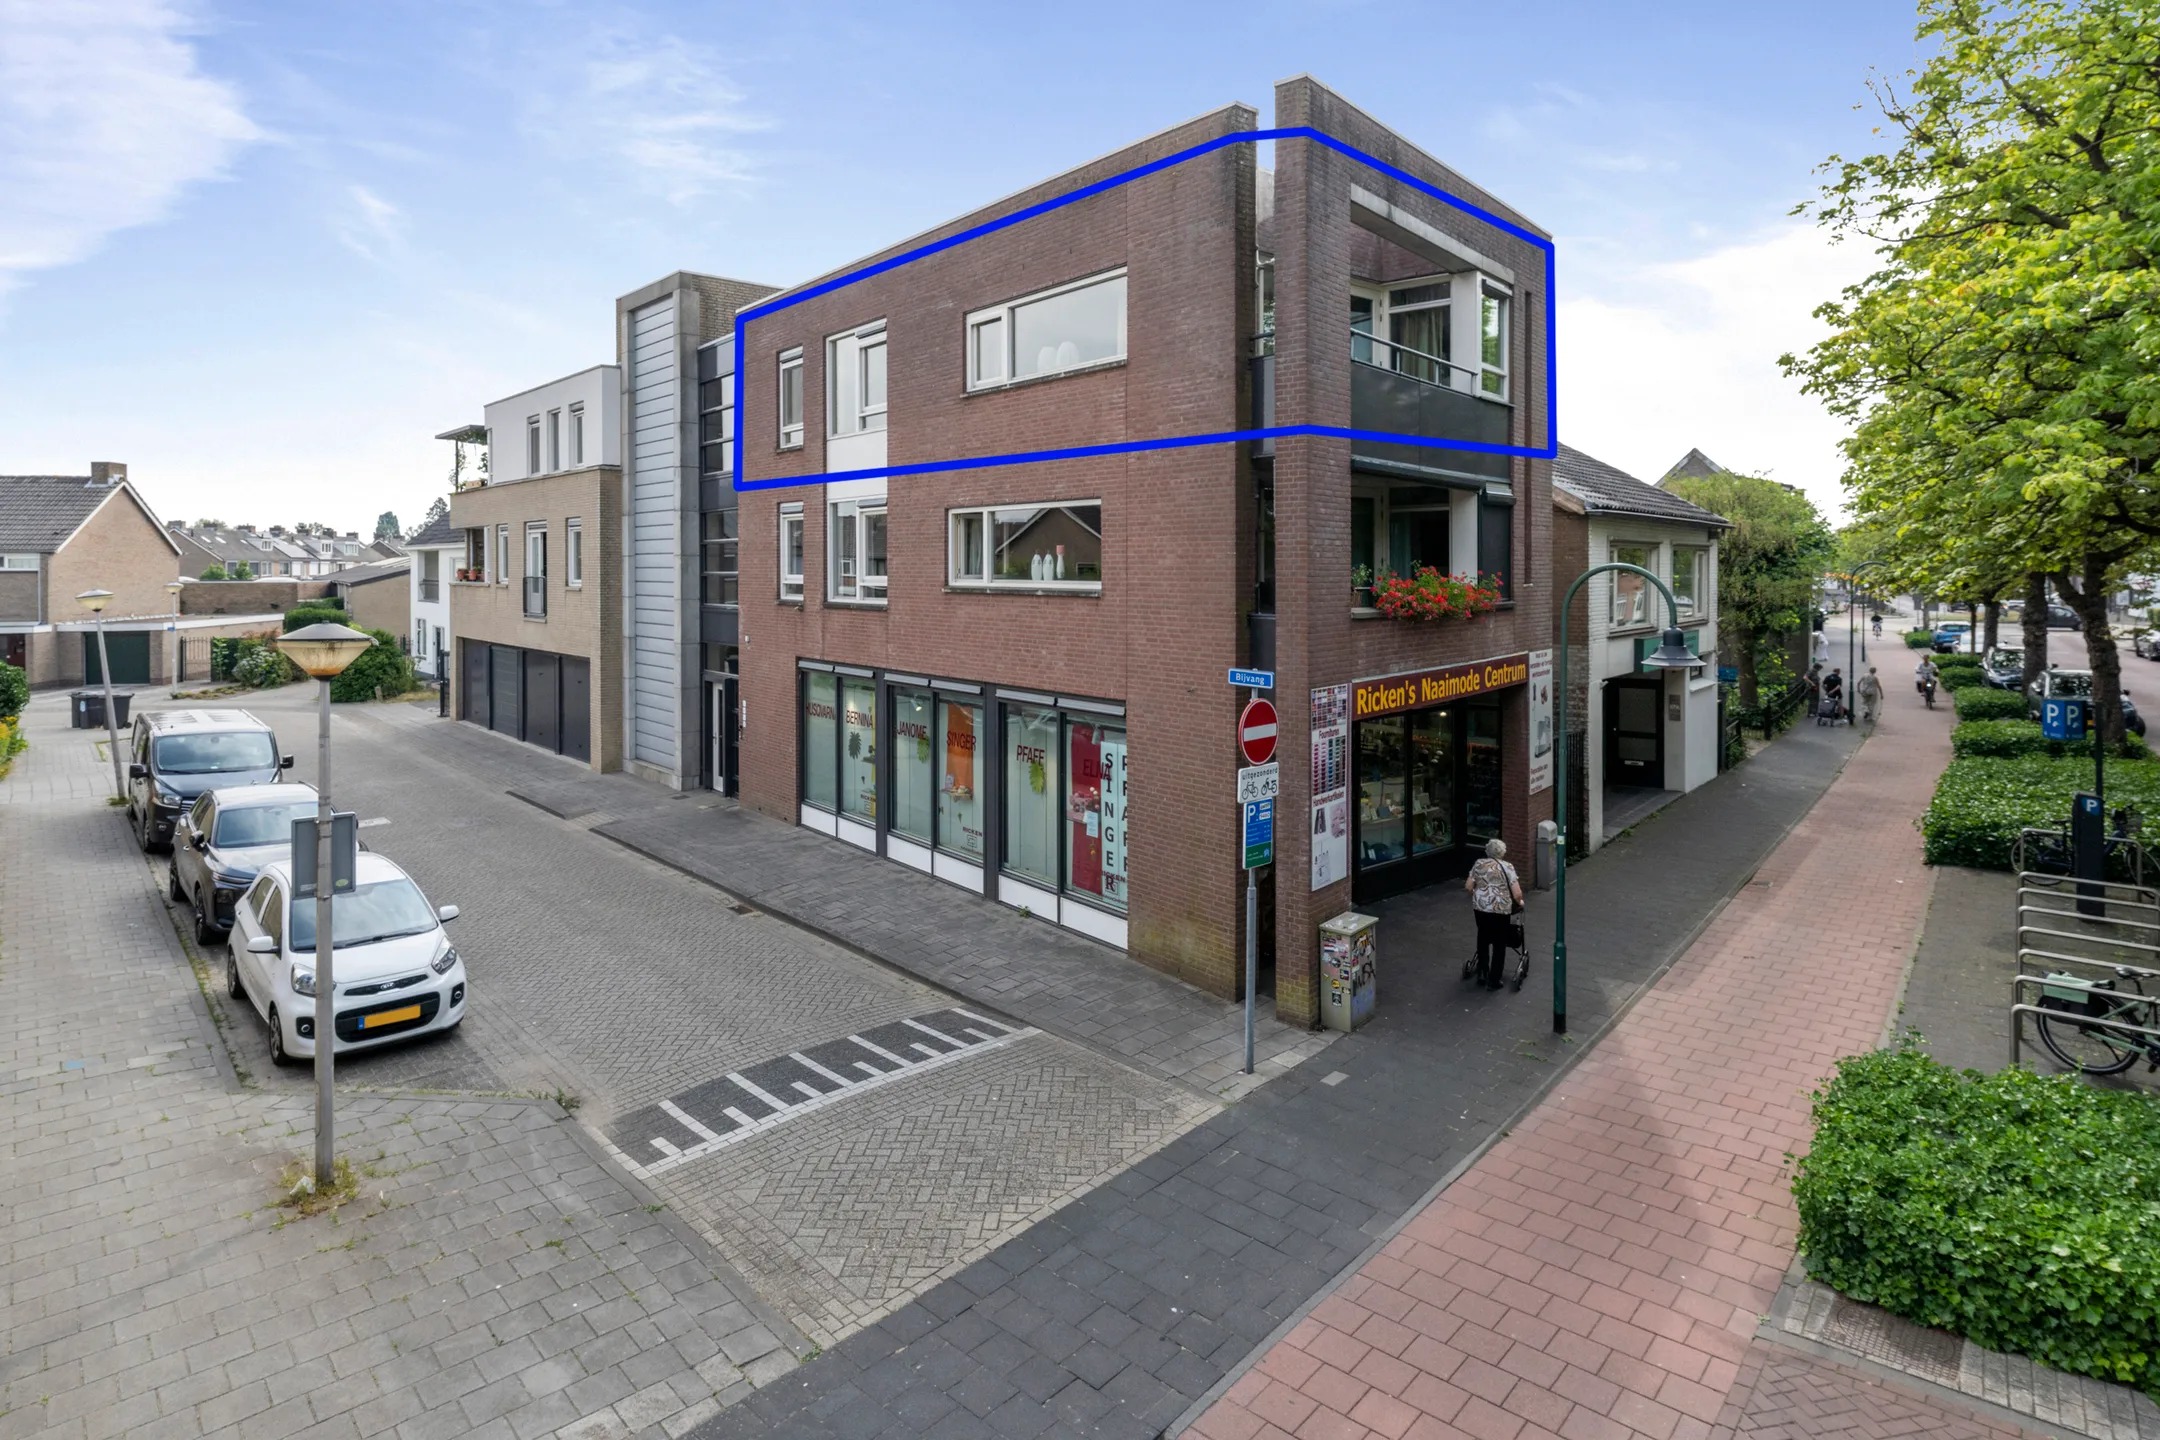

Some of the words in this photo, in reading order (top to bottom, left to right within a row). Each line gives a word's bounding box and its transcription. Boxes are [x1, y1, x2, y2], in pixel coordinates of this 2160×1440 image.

[1235, 672, 1265, 686] Bijvang
[1357, 680, 1416, 715] Ricken's
[1422, 669, 1481, 702] Naaimode
[1485, 663, 1527, 688] Centrum
[846, 709, 873, 728] BERNINA
[2046, 704, 2059, 724] P
[2066, 705, 2079, 726] P
[947, 730, 977, 752] SINGER
[1017, 744, 1045, 767] PFAFF
[1083, 758, 1112, 780] ELNA
[1242, 766, 1278, 781] uitgezonderd
[1248, 805, 1256, 823] P
[2086, 799, 2098, 812] P
